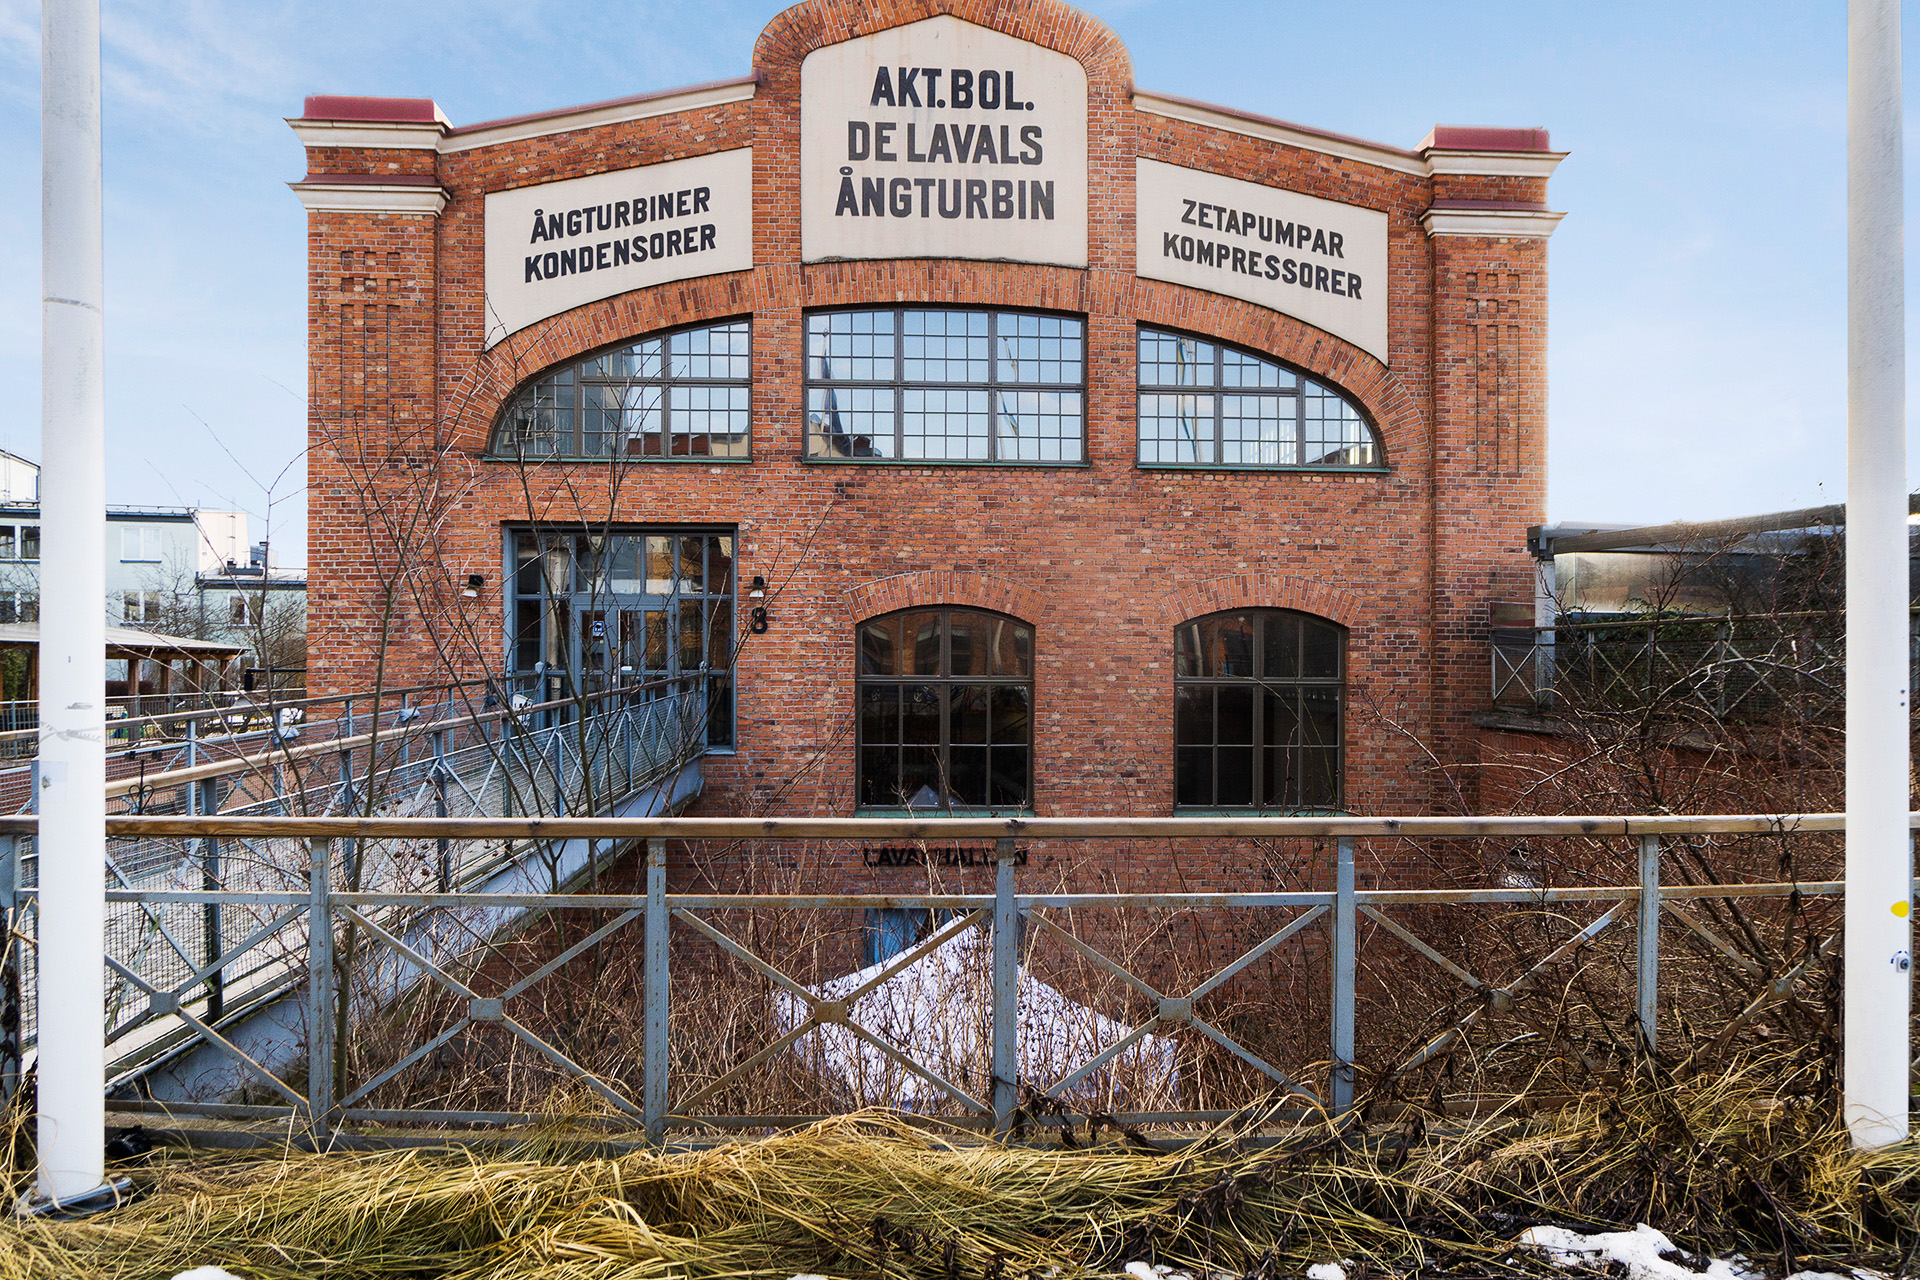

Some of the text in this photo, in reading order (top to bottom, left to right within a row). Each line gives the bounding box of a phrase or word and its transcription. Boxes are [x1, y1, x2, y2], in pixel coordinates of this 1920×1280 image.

[848, 121, 1043, 165] DE LAVALS
[530, 186, 711, 245] ÅNGTURBINER
[834, 166, 1055, 220] ÅNGTURBIN
[524, 223, 717, 284] KONDENSORER
[1181, 198, 1345, 259] ZETAPUMPAR
[1163, 231, 1363, 300] KOMPRESSORER
[751, 607, 768, 634] 8
[864, 847, 1028, 867] LAVALHALLN
